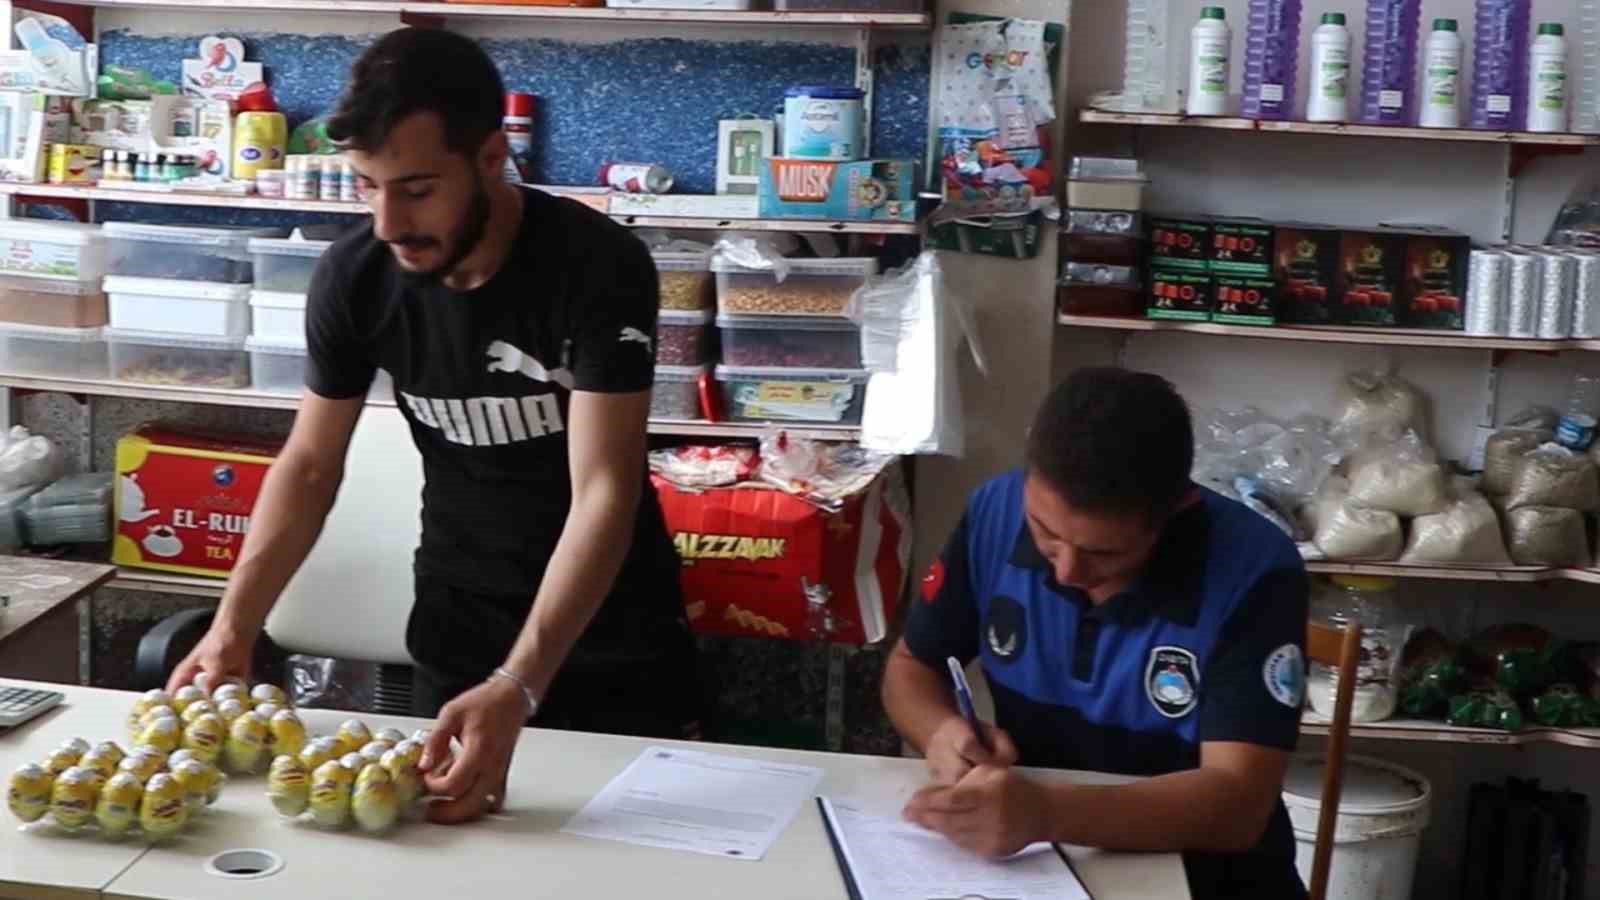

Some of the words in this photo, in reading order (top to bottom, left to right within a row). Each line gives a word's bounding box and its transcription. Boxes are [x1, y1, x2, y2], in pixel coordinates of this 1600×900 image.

[779, 163, 833, 196] MUSK
[400, 391, 565, 446] PUMA
[206, 545, 232, 561] TEA
